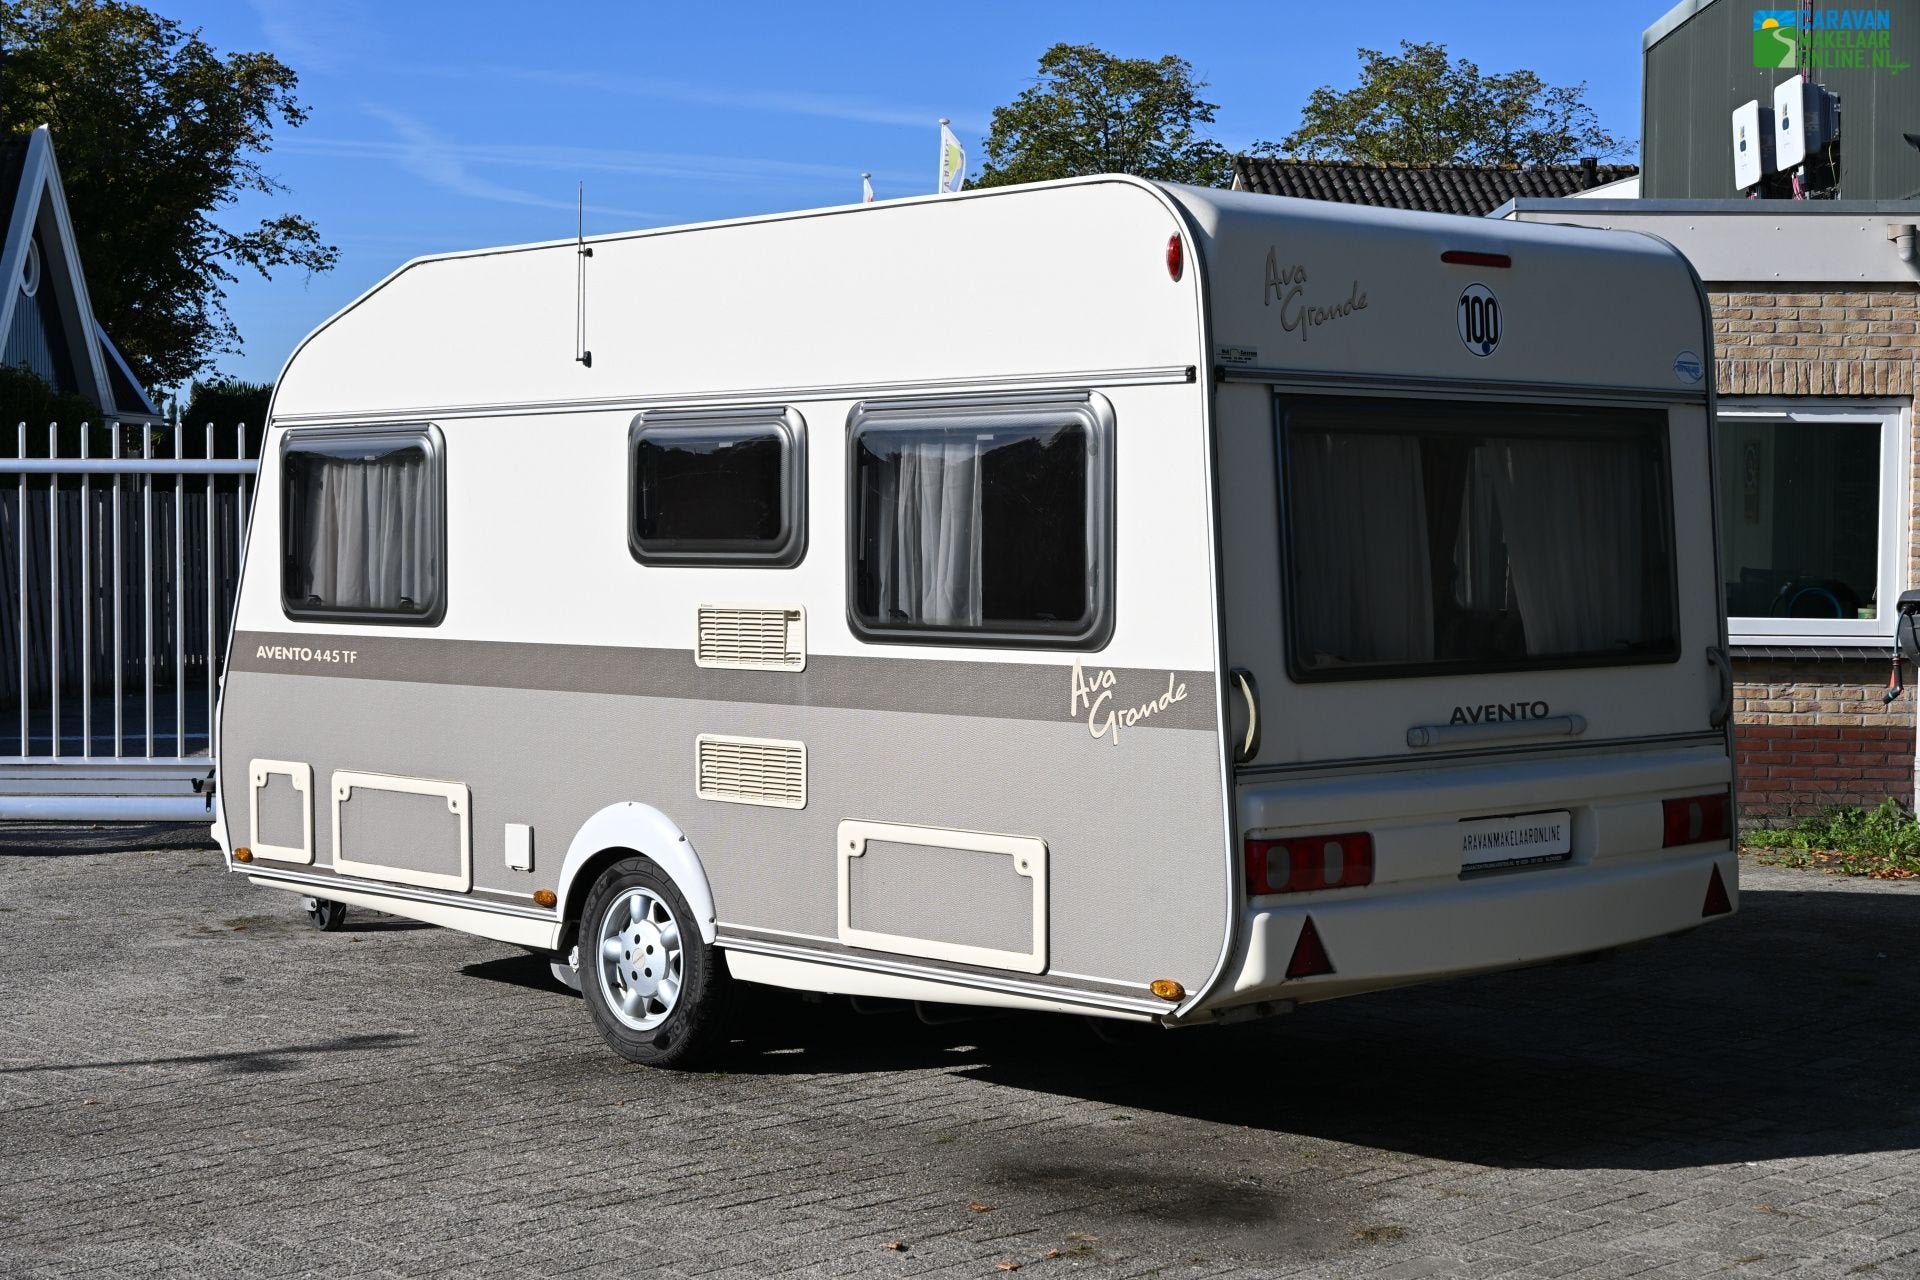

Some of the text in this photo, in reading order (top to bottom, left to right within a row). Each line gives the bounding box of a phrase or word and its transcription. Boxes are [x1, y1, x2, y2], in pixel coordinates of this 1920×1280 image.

[1264, 245, 1308, 306] Ava
[1280, 280, 1369, 342] Grande
[1461, 295, 1498, 345] 100
[256, 645, 358, 663] AVENTO 445 TF
[1070, 656, 1117, 717] Ava
[1088, 672, 1188, 746] Grande
[1449, 700, 1550, 726] AVENTO
[1462, 825, 1561, 852] ARAVANMAKELAARONLINE
